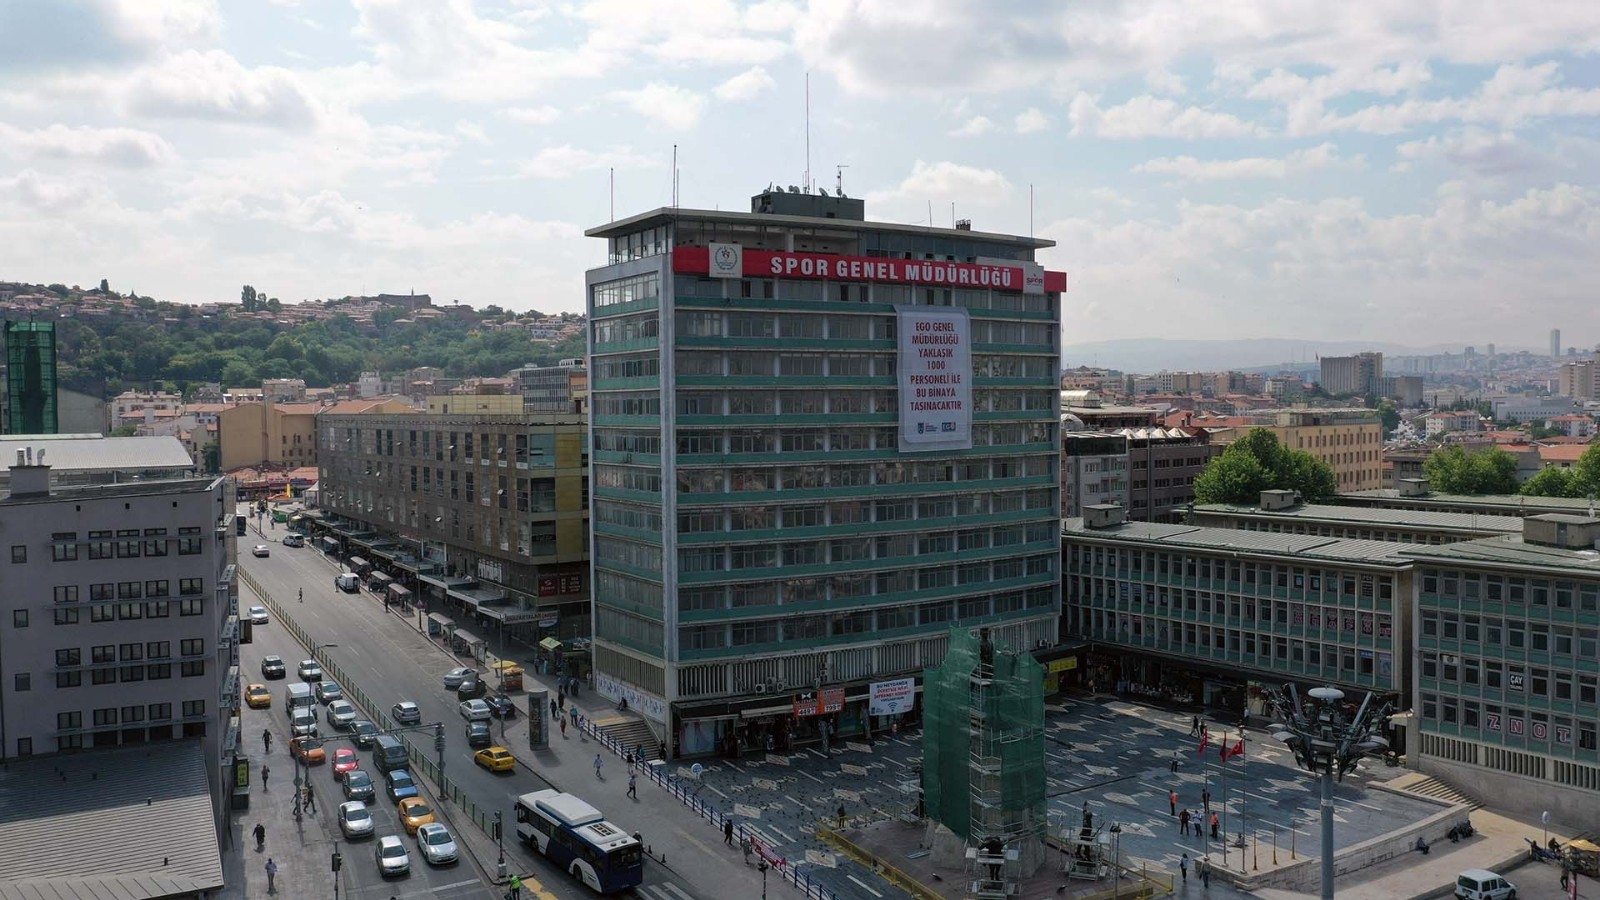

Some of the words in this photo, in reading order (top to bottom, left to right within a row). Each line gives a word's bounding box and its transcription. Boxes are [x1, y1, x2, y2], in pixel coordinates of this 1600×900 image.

[770, 256, 829, 276] SPOR
[836, 260, 899, 280] GENEL
[905, 262, 1011, 287] MÜDÜRLÜĞÜ
[915, 322, 931, 332] EGO
[932, 322, 955, 332] GENEL
[911, 333, 959, 345] MÜDÜRLÜĞÜ
[927, 360, 946, 370] 1000
[910, 373, 949, 385] PERSONELİ
[951, 374, 961, 384] İLE
[916, 388, 927, 398] BU
[928, 385, 956, 397] BİNAYA
[910, 400, 962, 413] TAŞINACAKTIR
[1510, 675, 1523, 685] ÇAY
